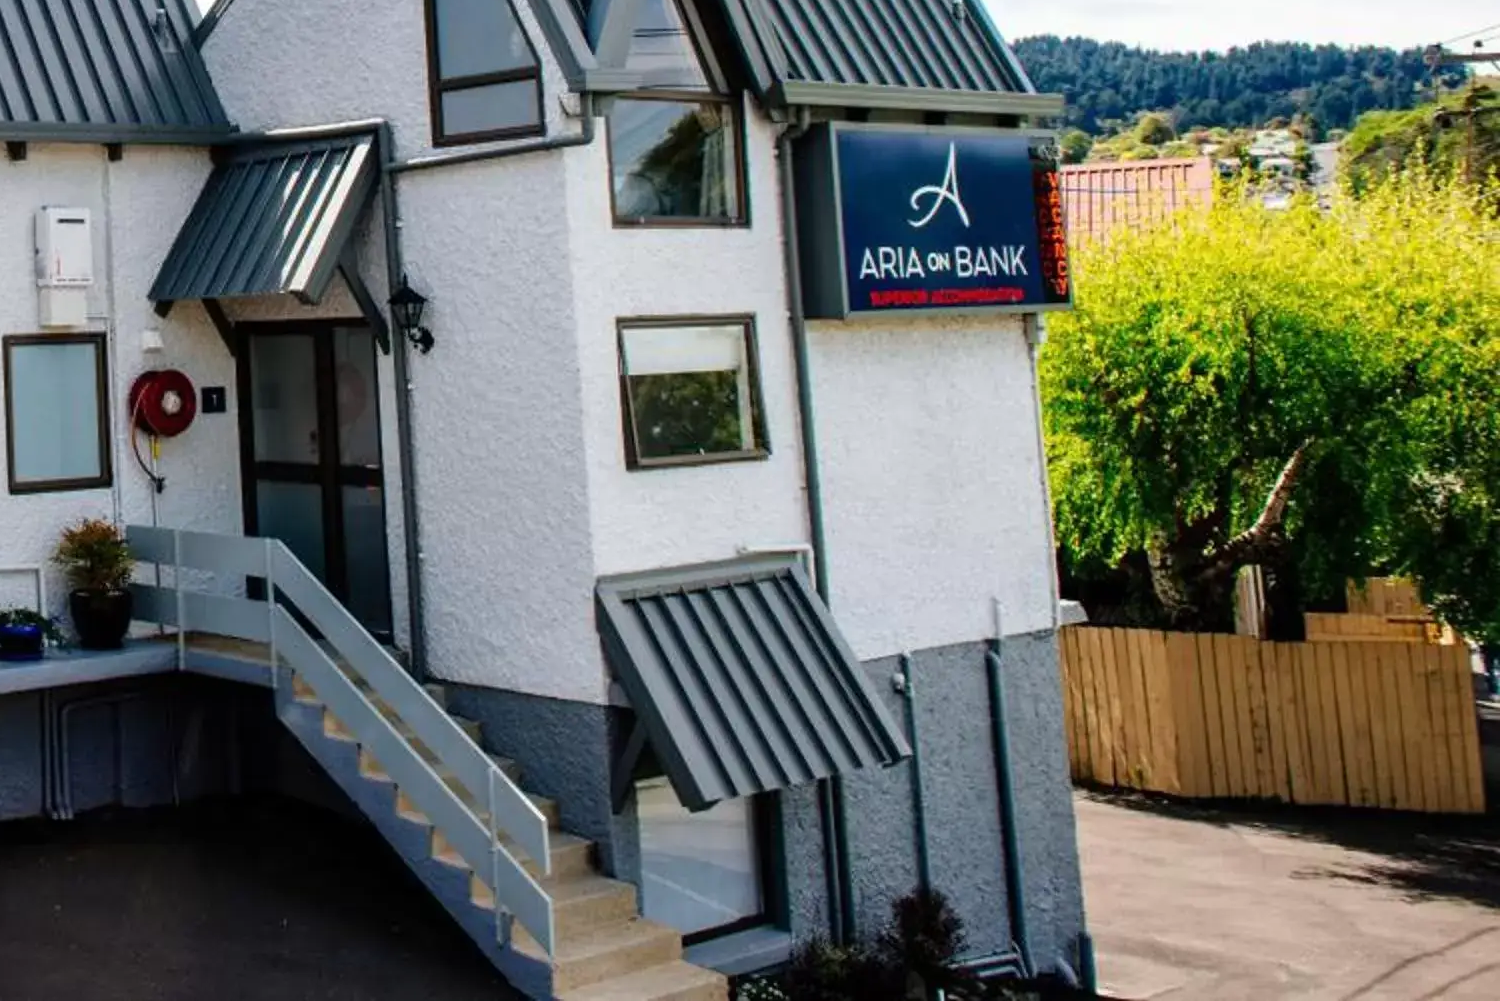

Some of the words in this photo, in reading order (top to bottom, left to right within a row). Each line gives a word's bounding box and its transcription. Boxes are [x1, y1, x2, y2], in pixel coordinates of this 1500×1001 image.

[907, 141, 970, 228] A
[860, 246, 924, 279] ARIA
[927, 253, 950, 271] ON
[955, 246, 1028, 277] BANK
[1047, 172, 1068, 295] VACANCY
